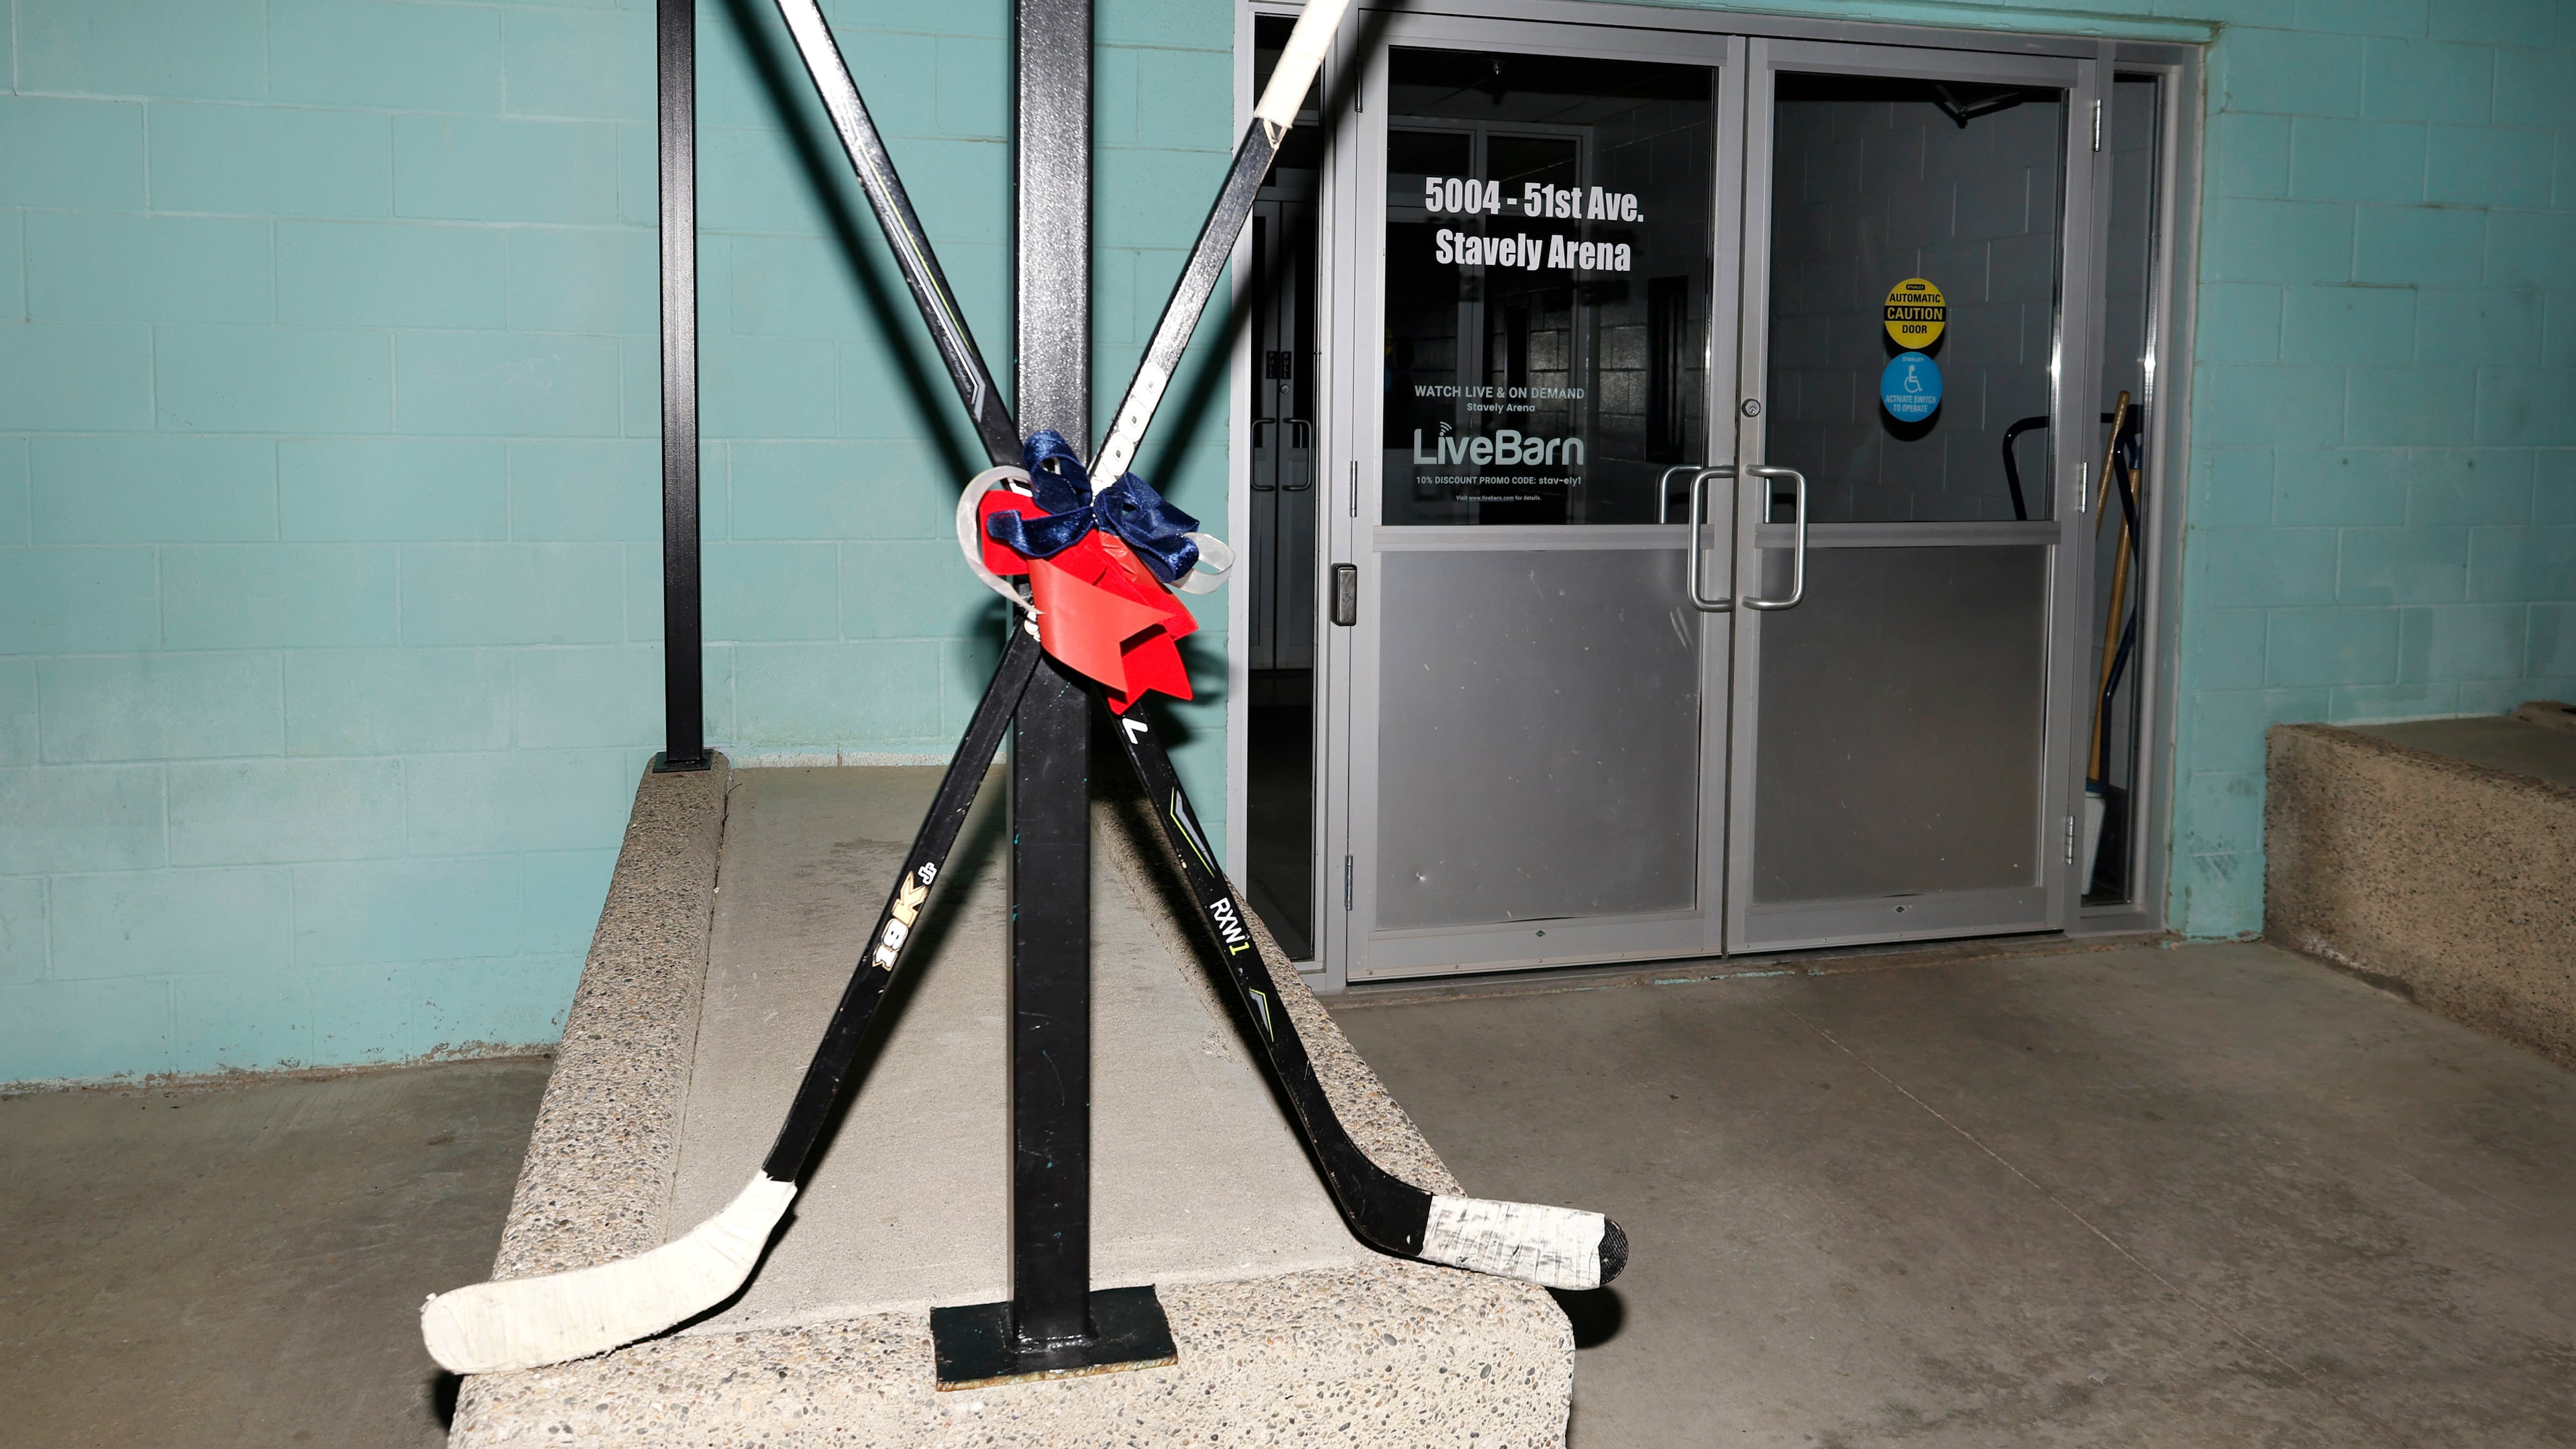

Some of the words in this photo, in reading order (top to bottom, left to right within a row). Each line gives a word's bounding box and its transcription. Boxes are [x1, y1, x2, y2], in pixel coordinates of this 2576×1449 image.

[1425, 176, 1501, 215] 5004
[1523, 182, 1582, 219] 51st
[1587, 186, 1644, 222] Ave.
[1436, 228, 1543, 271] Stavely
[1547, 234, 1631, 272] Arena
[1889, 293, 1941, 303] AUTOMATIC
[1886, 307, 1943, 321] CAUTION
[1902, 325, 1927, 334] DOOR
[1414, 385, 1461, 398] WATCH
[1465, 386, 1493, 398] LIVE
[1497, 387, 1505, 398] &
[1509, 387, 1527, 398] ON
[1531, 388, 1585, 399] DEMAND
[1885, 394, 1913, 403] ACTIVATE
[1913, 396, 1937, 404] SWITCH
[1467, 402, 1504, 414] Stavely
[1506, 403, 1536, 412] Arena
[1893, 404, 1901, 412] TO
[1902, 405, 1929, 413] OPERATE
[1413, 427, 1585, 466] LiveBarn
[1416, 476, 1433, 484] 10%
[1435, 476, 1478, 484] DISCOUNT
[1479, 476, 1510, 484] PROMO
[1511, 476, 1537, 484] CODE:
[1210, 897, 1250, 956] RXW1
